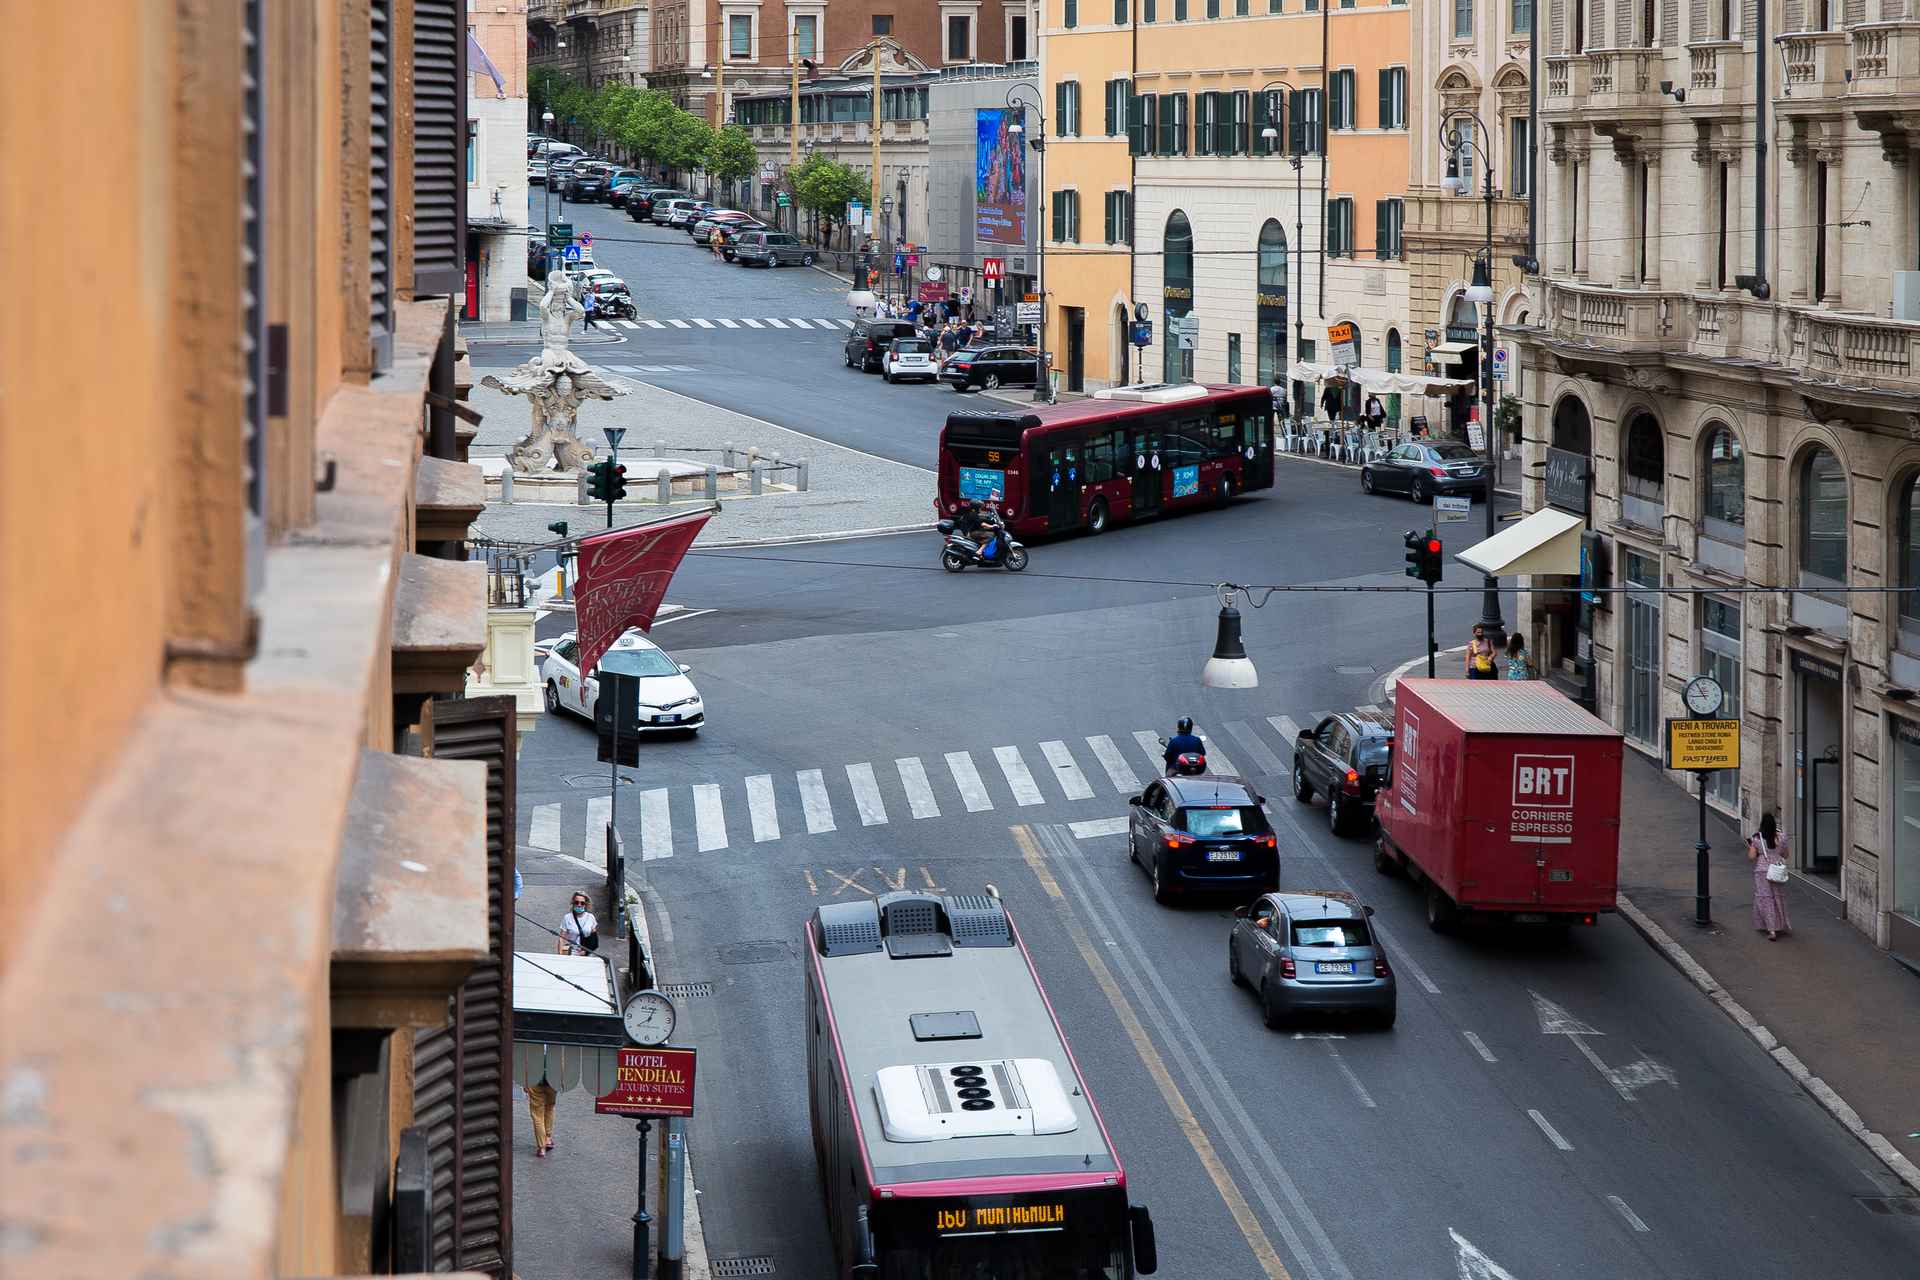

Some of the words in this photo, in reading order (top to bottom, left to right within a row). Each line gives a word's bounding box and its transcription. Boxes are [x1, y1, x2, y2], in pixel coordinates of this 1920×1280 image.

[985, 262, 998, 275] M
[1330, 327, 1350, 338] TAXI
[988, 451, 1000, 462] 59
[1673, 722, 1693, 730] VIENI
[1694, 722, 1699, 730] A
[1701, 722, 1737, 730] TROVARCI
[1404, 722, 1417, 760] BRT
[1519, 766, 1569, 795] BRT
[1511, 809, 1573, 822] CORRIERE
[1510, 822, 1573, 833] ESPRESSO
[624, 1054, 667, 1068] HOTEL
[616, 1067, 685, 1084] TENDHAL
[652, 1084, 685, 1094] SUITES
